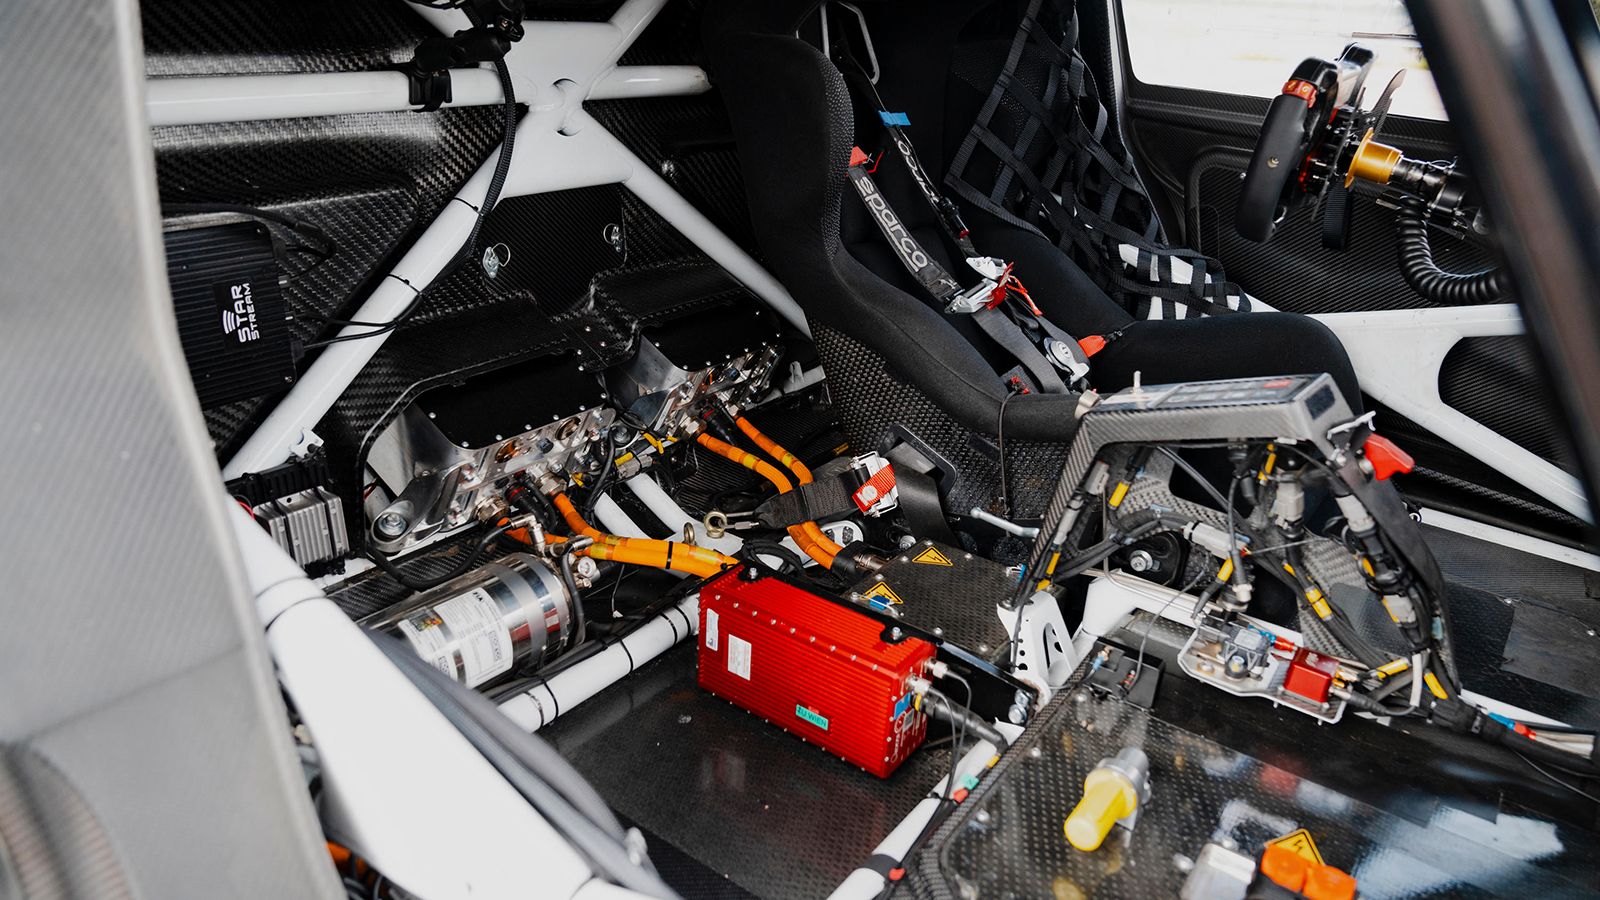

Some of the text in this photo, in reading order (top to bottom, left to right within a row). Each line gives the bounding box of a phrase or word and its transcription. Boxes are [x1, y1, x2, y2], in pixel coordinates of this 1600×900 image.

[854, 176, 928, 272] sparco
[231, 285, 252, 343] STAR
[242, 282, 260, 340] STREAM
